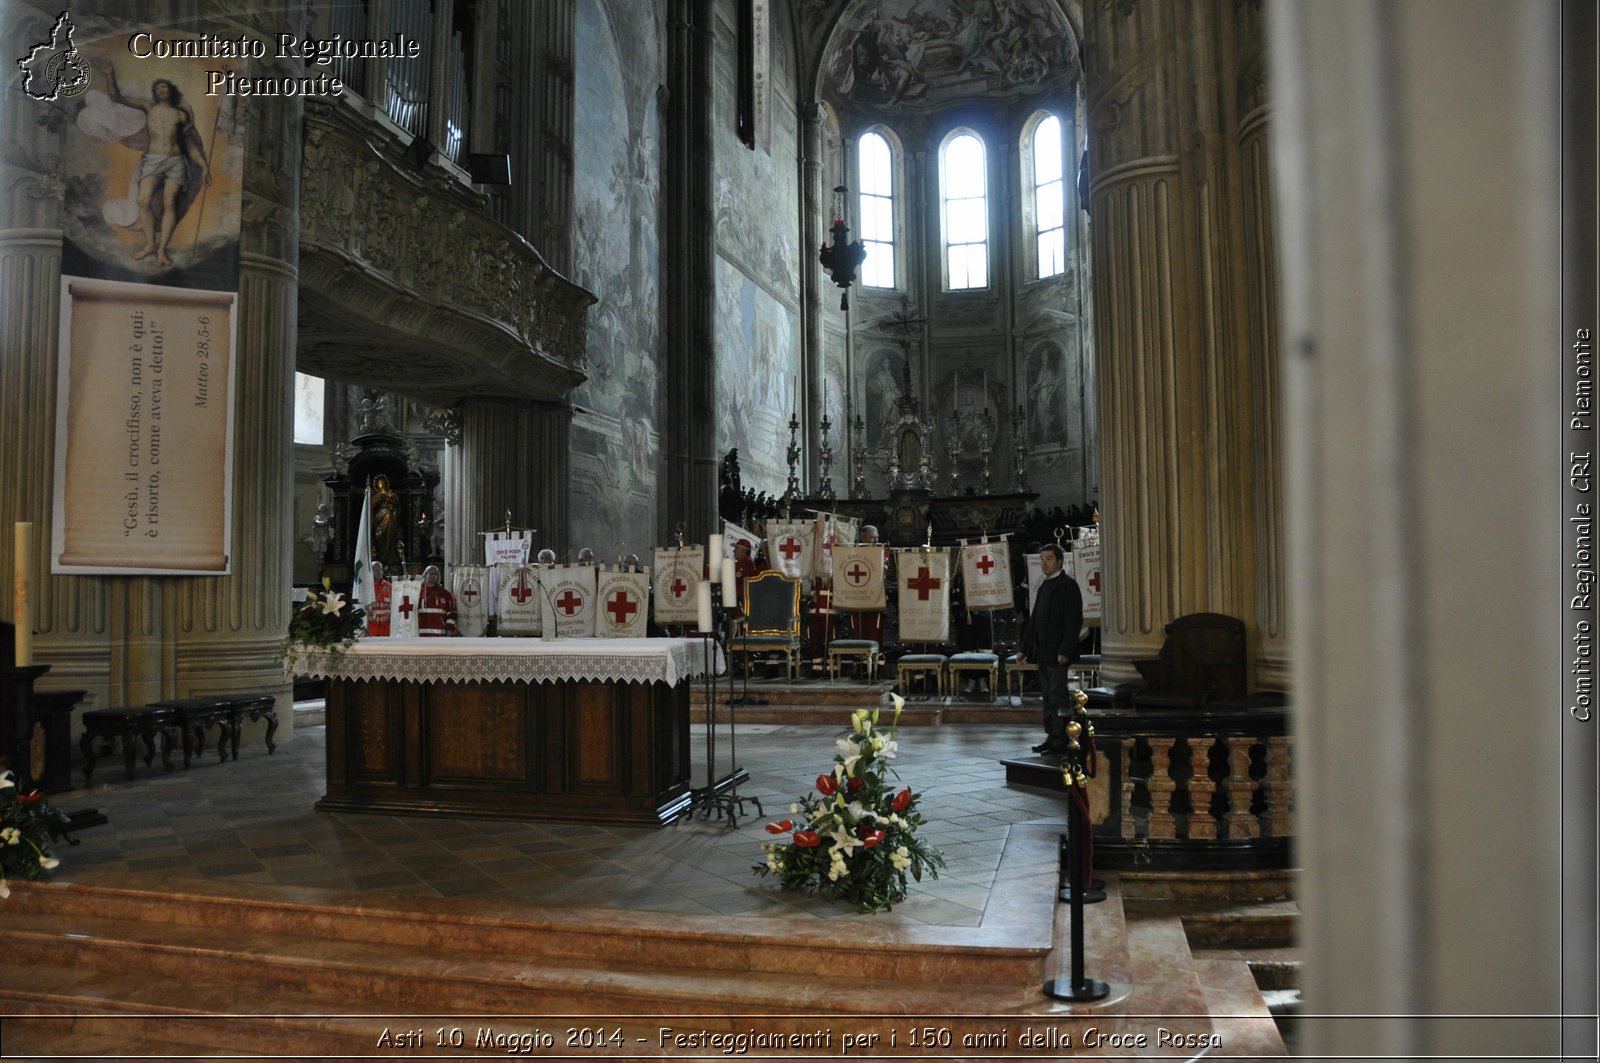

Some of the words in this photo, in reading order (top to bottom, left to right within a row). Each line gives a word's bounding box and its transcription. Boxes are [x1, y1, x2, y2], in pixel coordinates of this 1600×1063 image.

[130, 310, 147, 339] qui:
[196, 316, 212, 359] 28,5-6
[128, 343, 143, 352] è
[131, 357, 142, 386] non
[195, 362, 209, 408] Matteo
[151, 379, 162, 420] aveva
[126, 391, 144, 467] crocifisso,
[150, 425, 161, 465] come
[124, 472, 139, 481] il
[145, 471, 162, 524] risorto,
[144, 529, 158, 538] è
